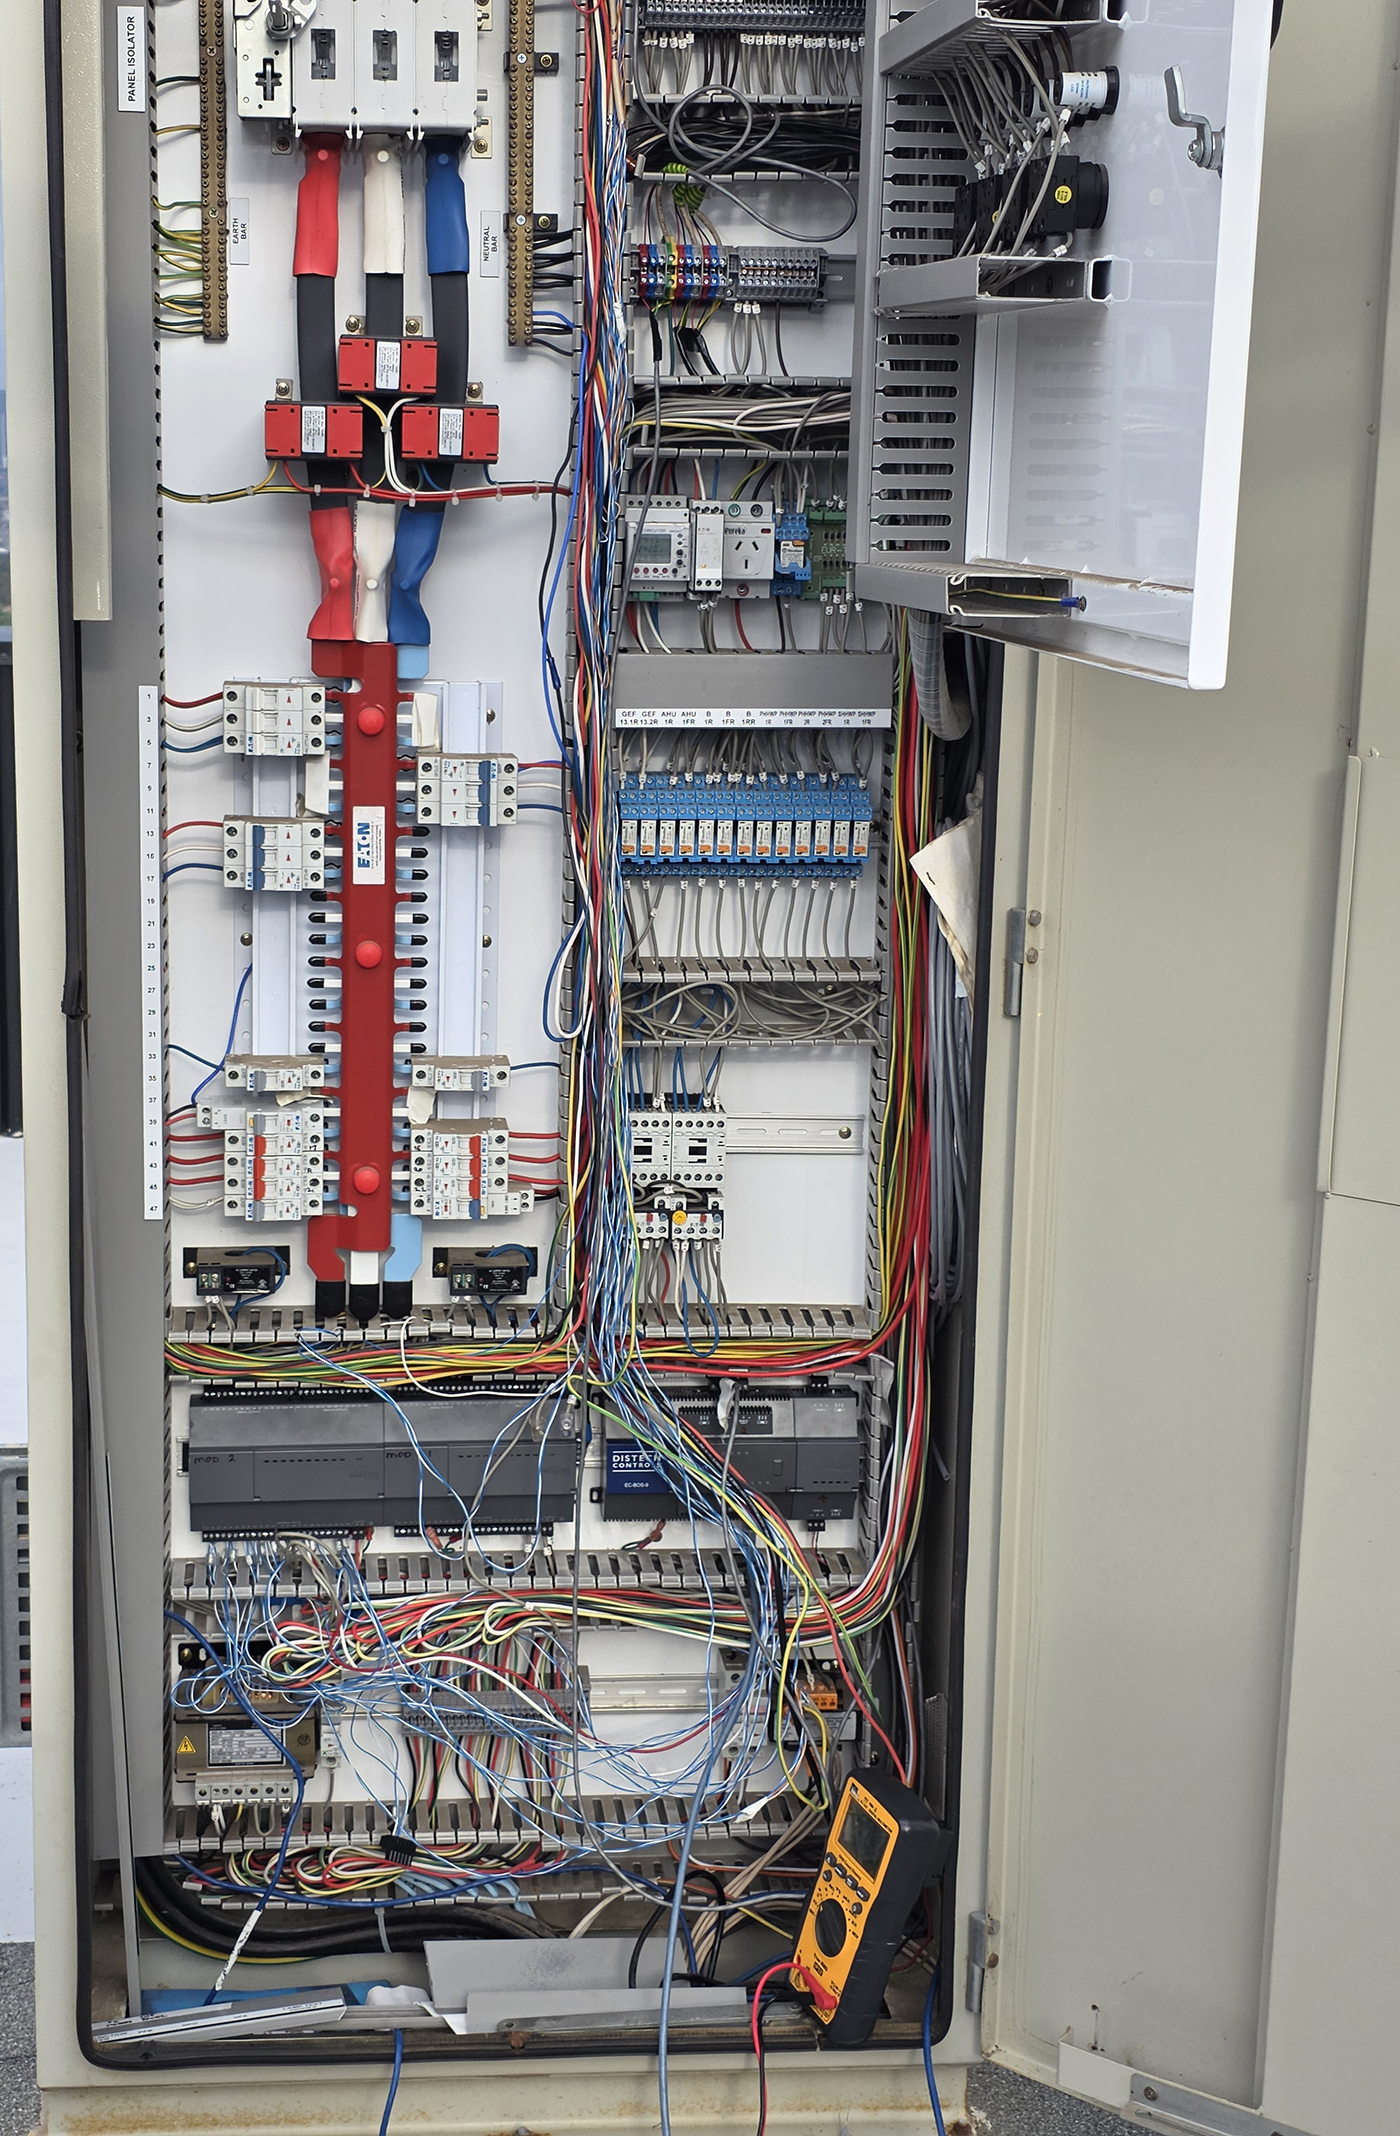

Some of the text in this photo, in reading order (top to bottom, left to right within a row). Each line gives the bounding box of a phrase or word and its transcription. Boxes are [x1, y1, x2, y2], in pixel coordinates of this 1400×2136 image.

[127, 16, 135, 102] PANEL ISOLATOR
[357, 822, 370, 868] EATON
[228, 1454, 236, 1463] 2
